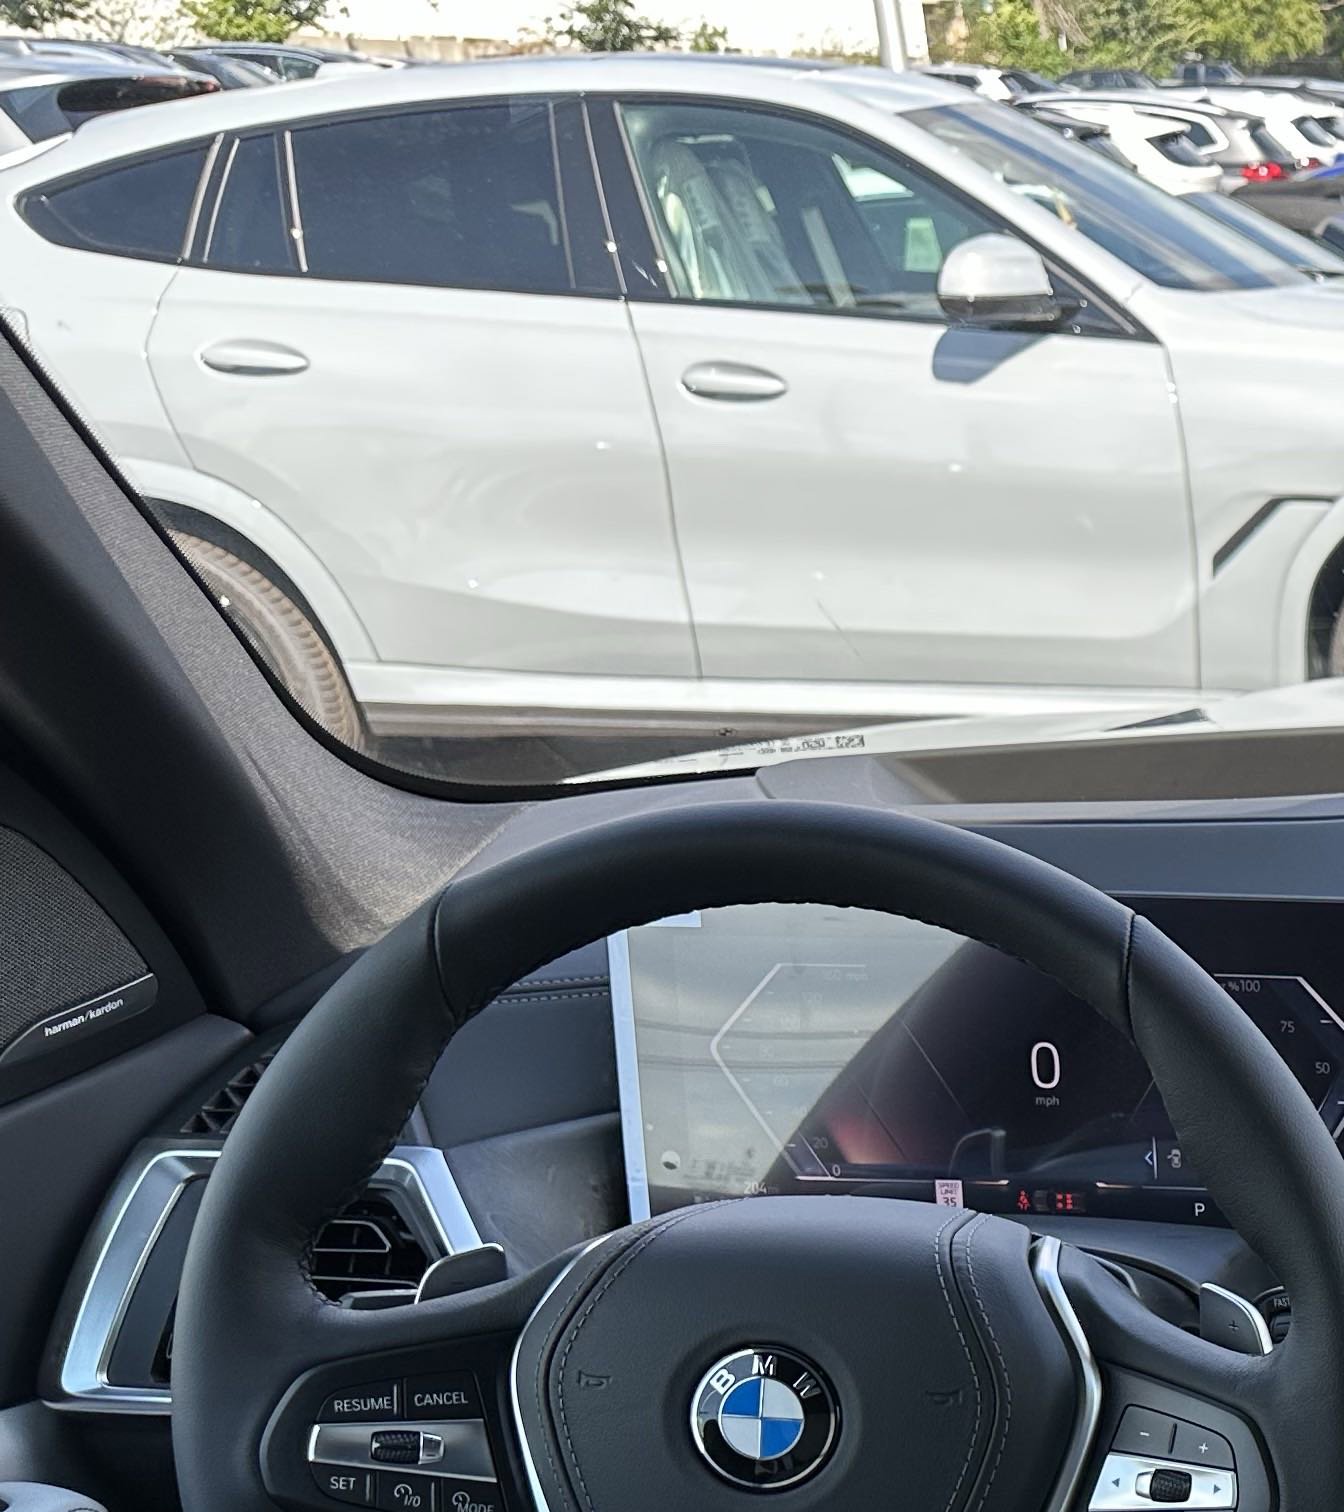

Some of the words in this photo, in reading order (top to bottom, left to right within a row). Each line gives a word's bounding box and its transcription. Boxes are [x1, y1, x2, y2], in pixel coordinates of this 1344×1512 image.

[44, 998, 124, 1037] harman/kardon
[1280, 1020, 1295, 1033] 75
[1030, 1041, 1061, 1089] 0
[1315, 1062, 1331, 1074] 50
[1035, 1095, 1060, 1107] mph
[813, 1137, 828, 1149] 20
[831, 1165, 841, 1177] 0
[943, 1197, 958, 1208] 35
[1194, 1203, 1205, 1216] P
[709, 1354, 822, 1399] BMW
[334, 1396, 393, 1413] RESUME
[414, 1391, 469, 1407] CANCEL
[329, 1476, 356, 1491] SET
